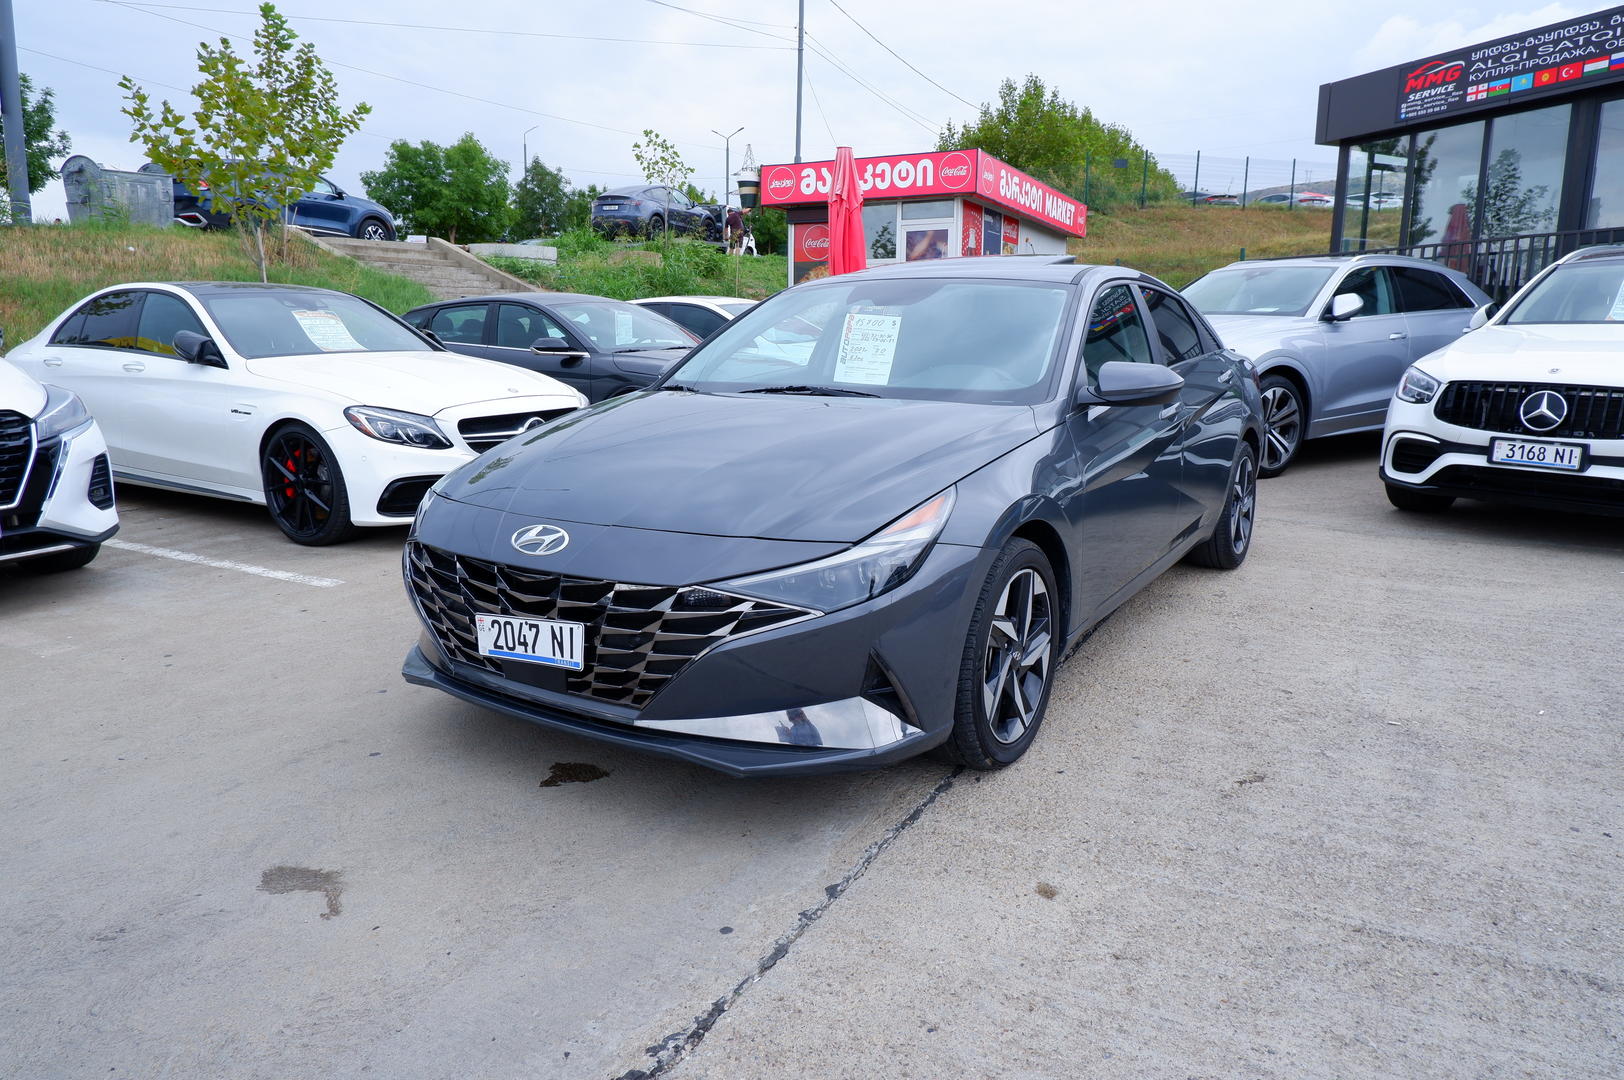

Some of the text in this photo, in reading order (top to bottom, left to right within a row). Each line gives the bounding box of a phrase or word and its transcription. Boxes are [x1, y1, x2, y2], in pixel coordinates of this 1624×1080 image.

[1610, 14, 1624, 26] გ
[1469, 45, 1600, 82] КУПЛЯ-ПРОДАЖА,
[1470, 26, 1622, 72] ALQI SATQI
[1404, 65, 1463, 93] MMG
[1407, 83, 1457, 102] SERVICE
[800, 158, 934, 195] მაკეტი
[999, 169, 1076, 226] მარკეტი MARKET
[1506, 443, 1574, 465] 3168 NI
[490, 619, 574, 660] 2047 NI
